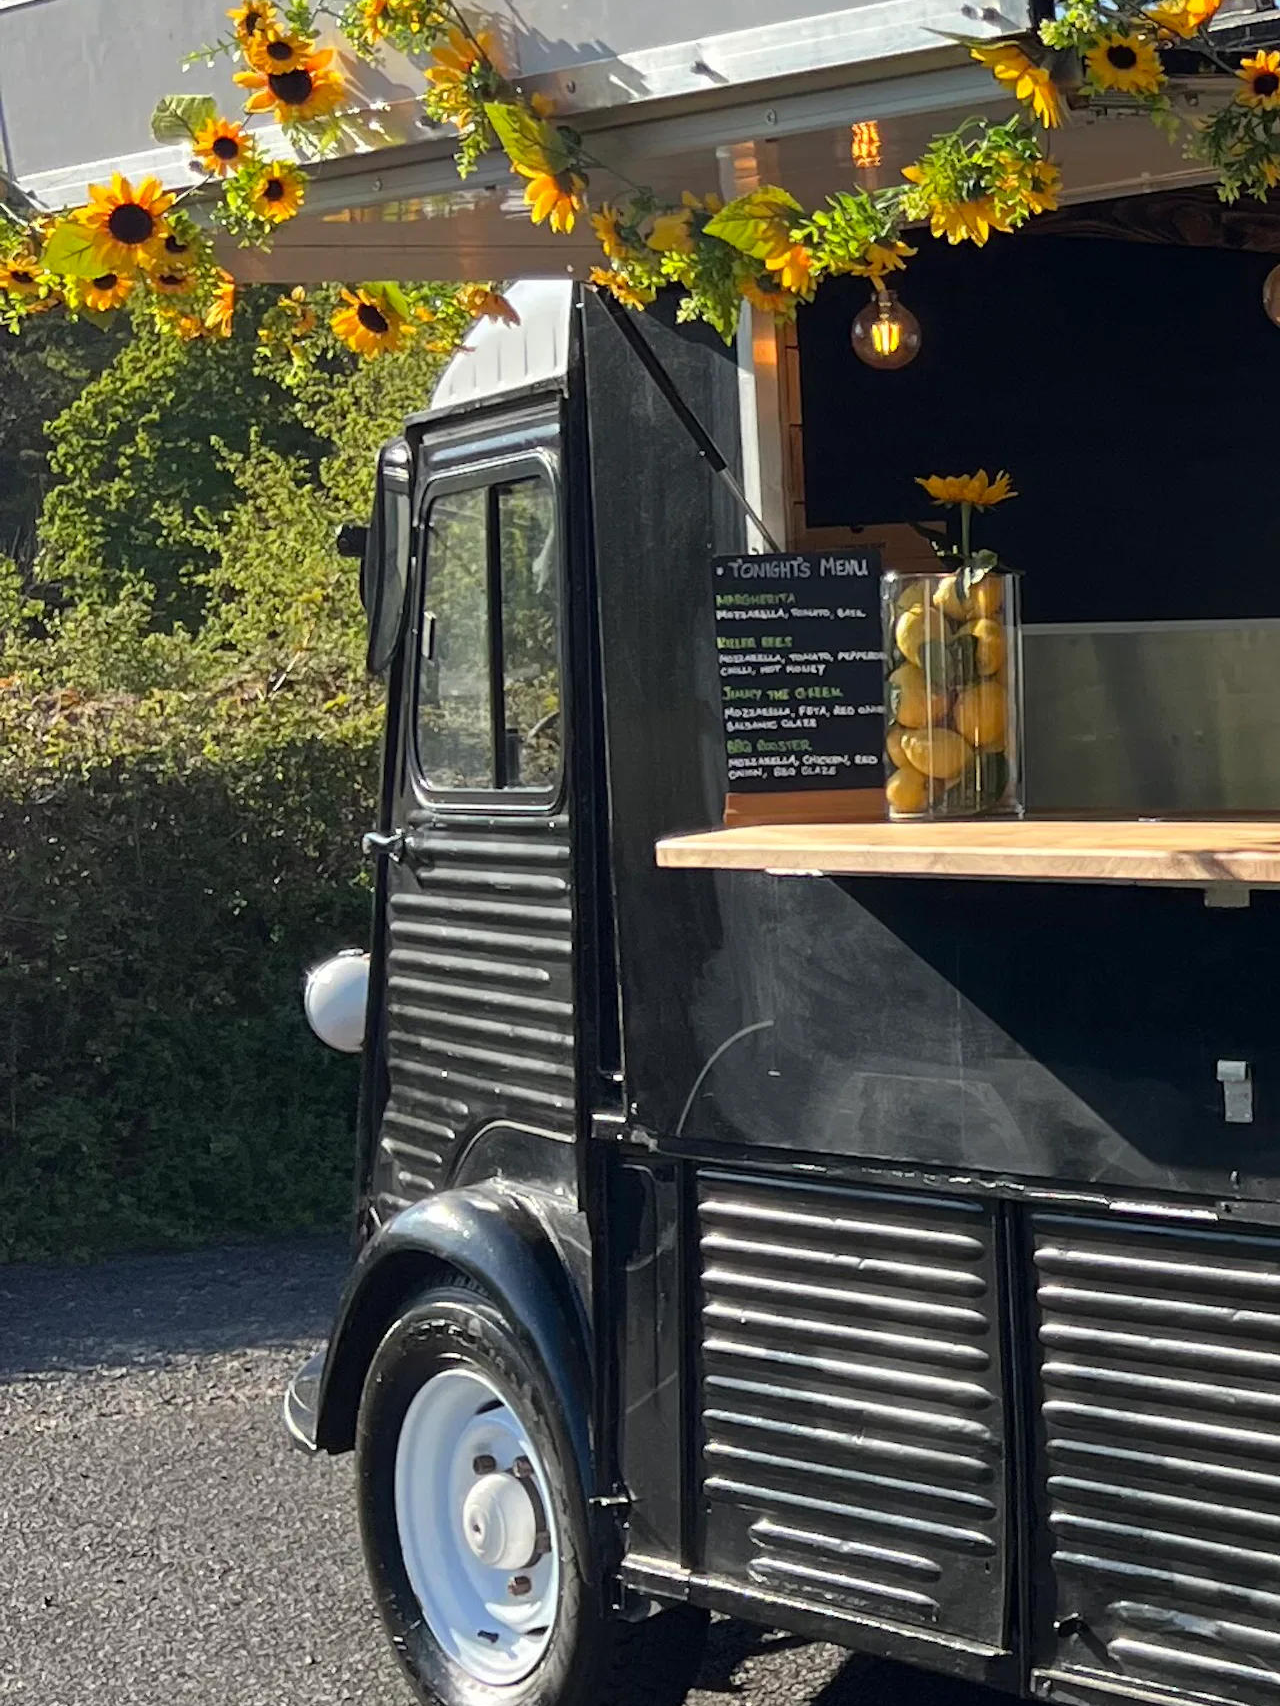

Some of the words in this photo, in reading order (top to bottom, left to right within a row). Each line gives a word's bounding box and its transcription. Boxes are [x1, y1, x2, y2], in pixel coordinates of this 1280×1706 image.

[819, 556, 869, 578] MENU
[766, 688, 790, 701] THE
[726, 739, 752, 754] BBQ
[756, 739, 813, 753] ROOSTER
